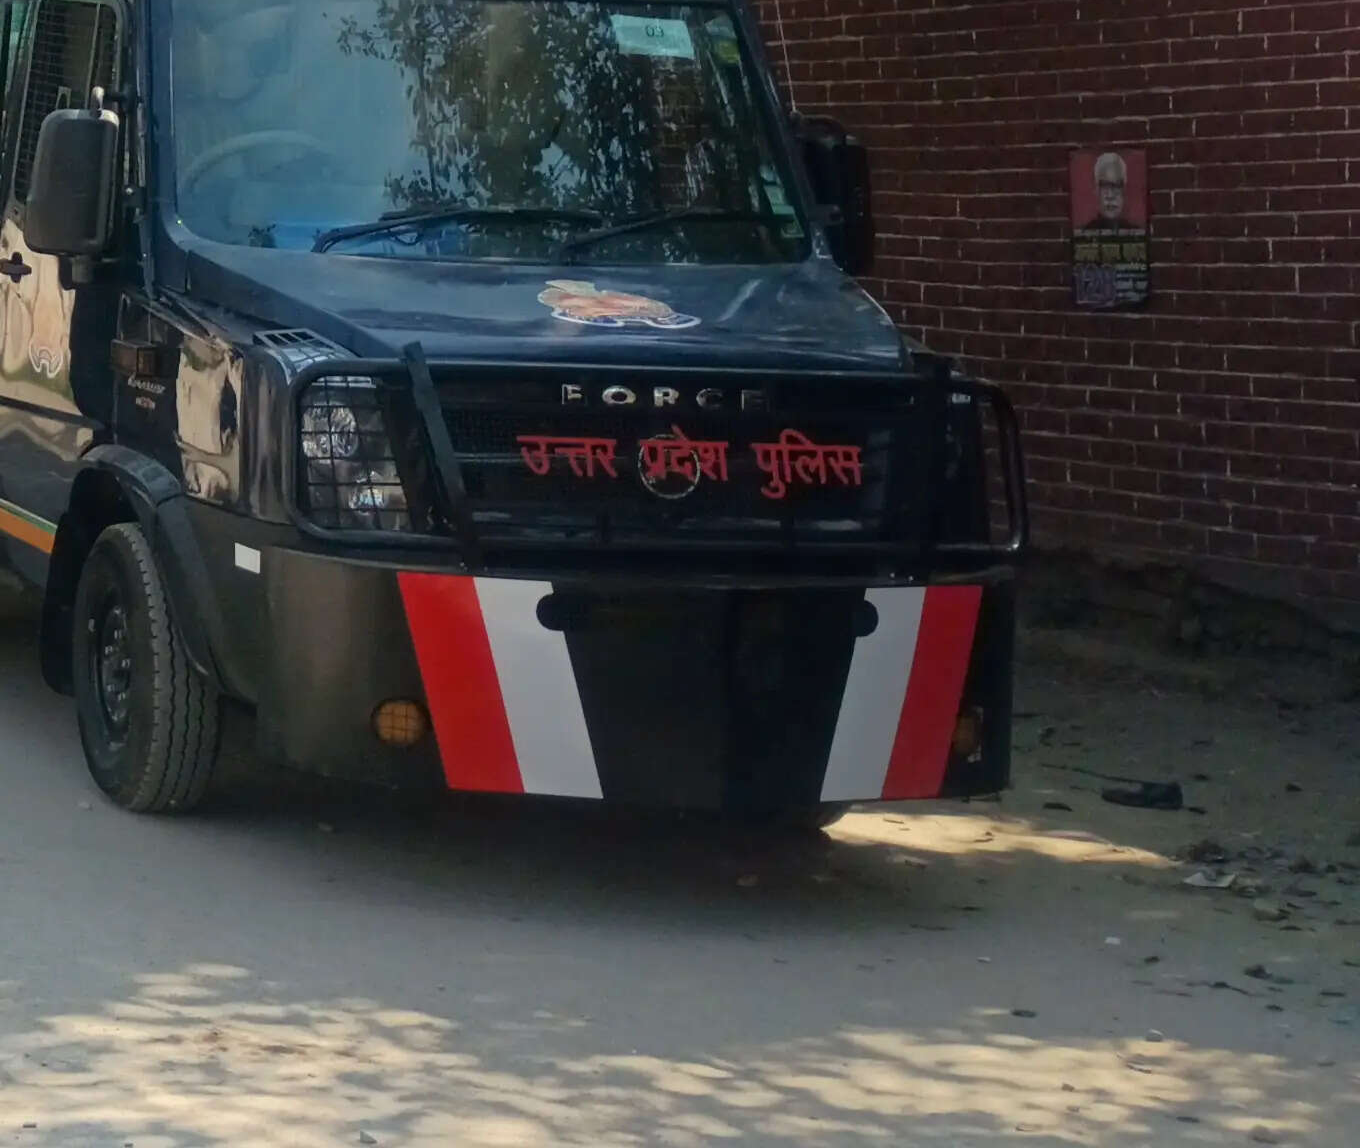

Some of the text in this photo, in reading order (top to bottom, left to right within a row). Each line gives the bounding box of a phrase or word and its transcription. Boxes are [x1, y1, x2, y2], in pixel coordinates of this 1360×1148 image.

[561, 383, 770, 412] FORCE
[516, 423, 862, 499] उत्तर प्रदेश पुलिस
